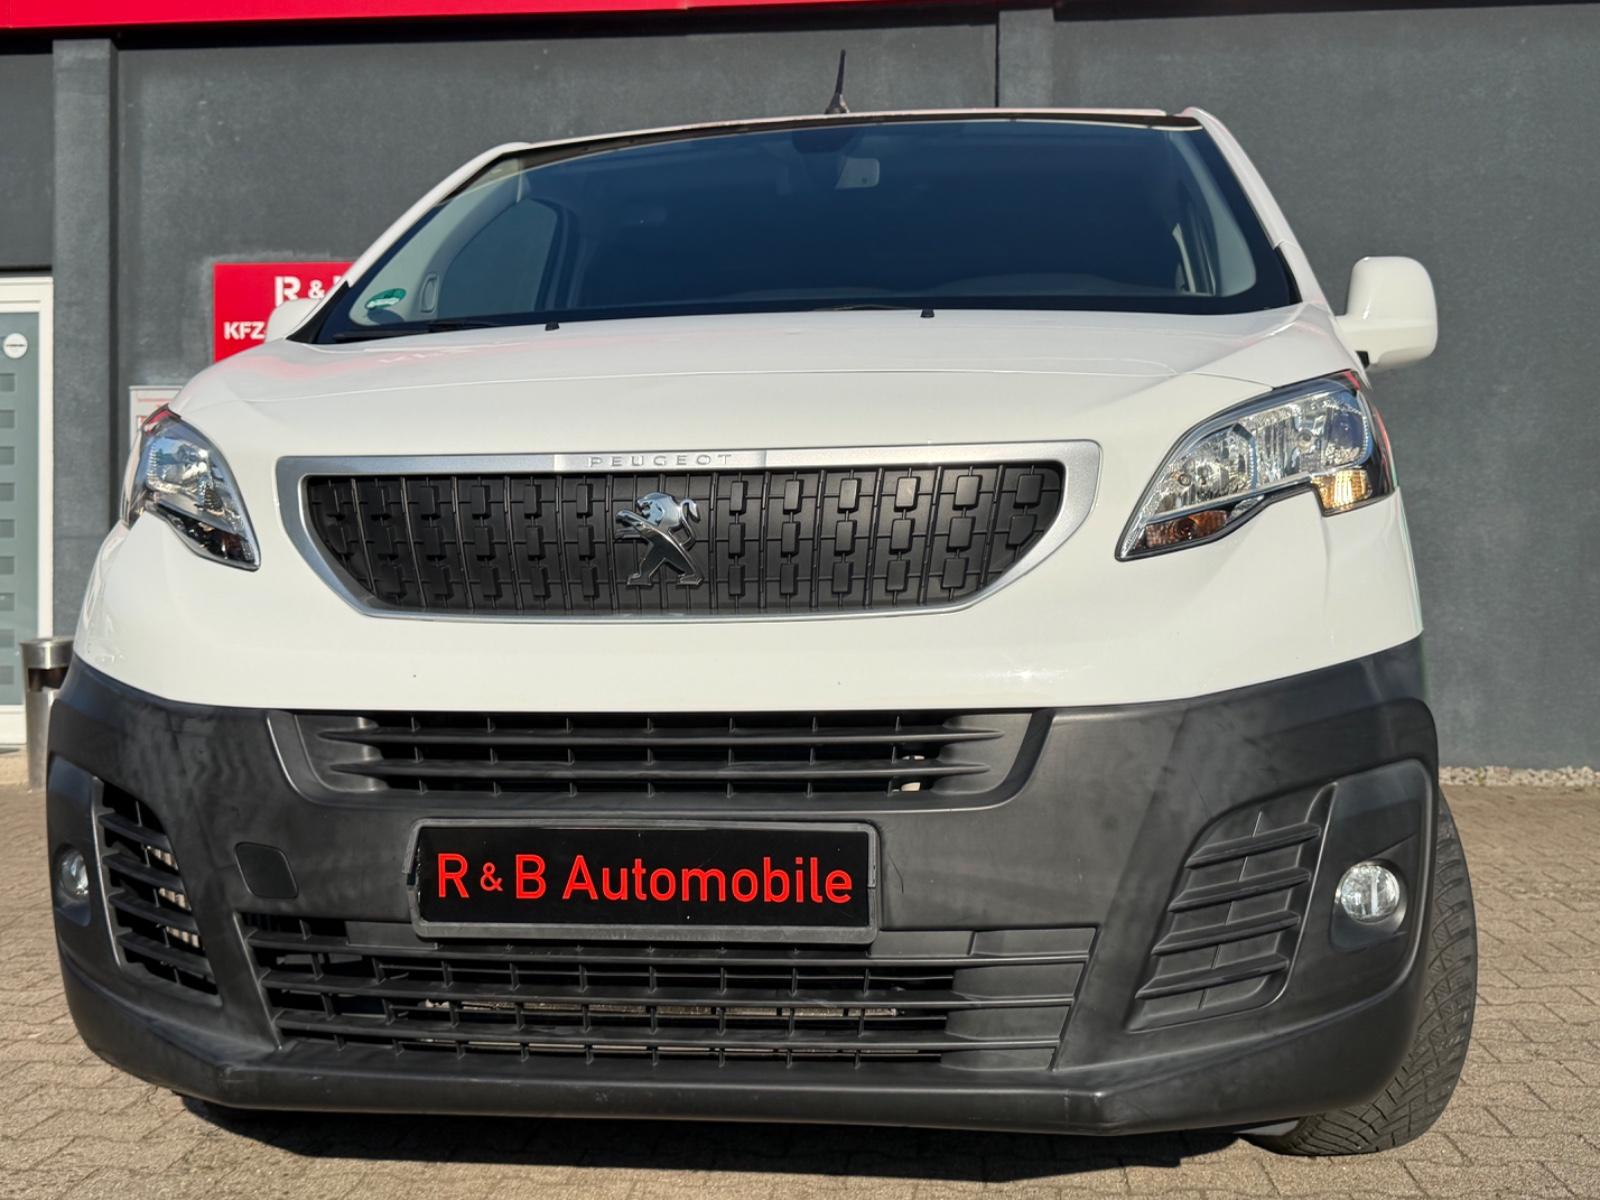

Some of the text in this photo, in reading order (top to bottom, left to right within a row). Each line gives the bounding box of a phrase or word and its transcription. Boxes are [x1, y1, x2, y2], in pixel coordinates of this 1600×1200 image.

[275, 276, 301, 307] R
[588, 454, 732, 467] PEUGEOT
[437, 852, 853, 904] R & B Automobile
